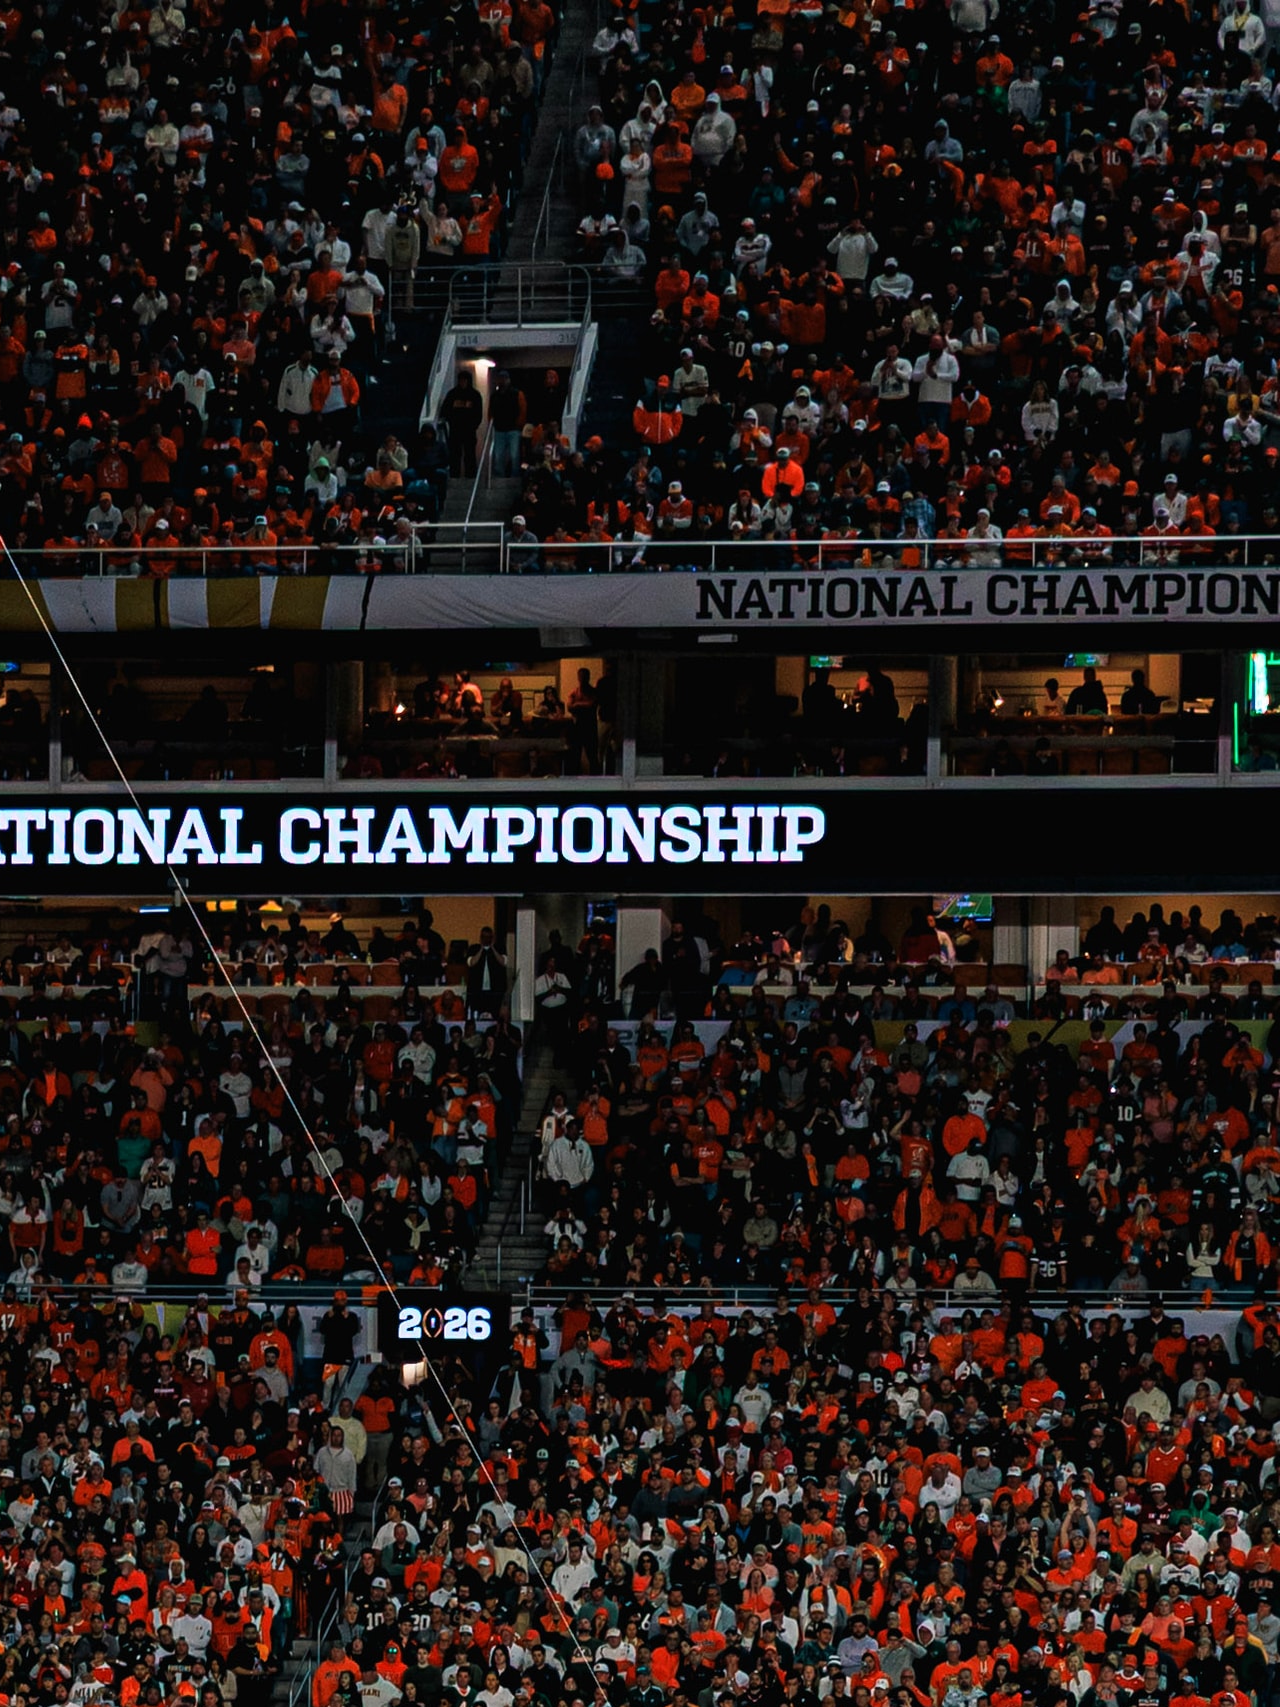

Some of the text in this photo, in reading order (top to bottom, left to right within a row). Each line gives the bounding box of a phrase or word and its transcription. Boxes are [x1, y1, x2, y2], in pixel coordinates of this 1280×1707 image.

[696, 571, 1280, 619] NATIONAL CHAMPION
[279, 804, 826, 866] CHAMPIONSHIP
[1118, 1105, 1133, 1122] 10
[1040, 1261, 1057, 1278] 26
[0, 1313, 16, 1331] 17
[1206, 1605, 1213, 1624] 1
